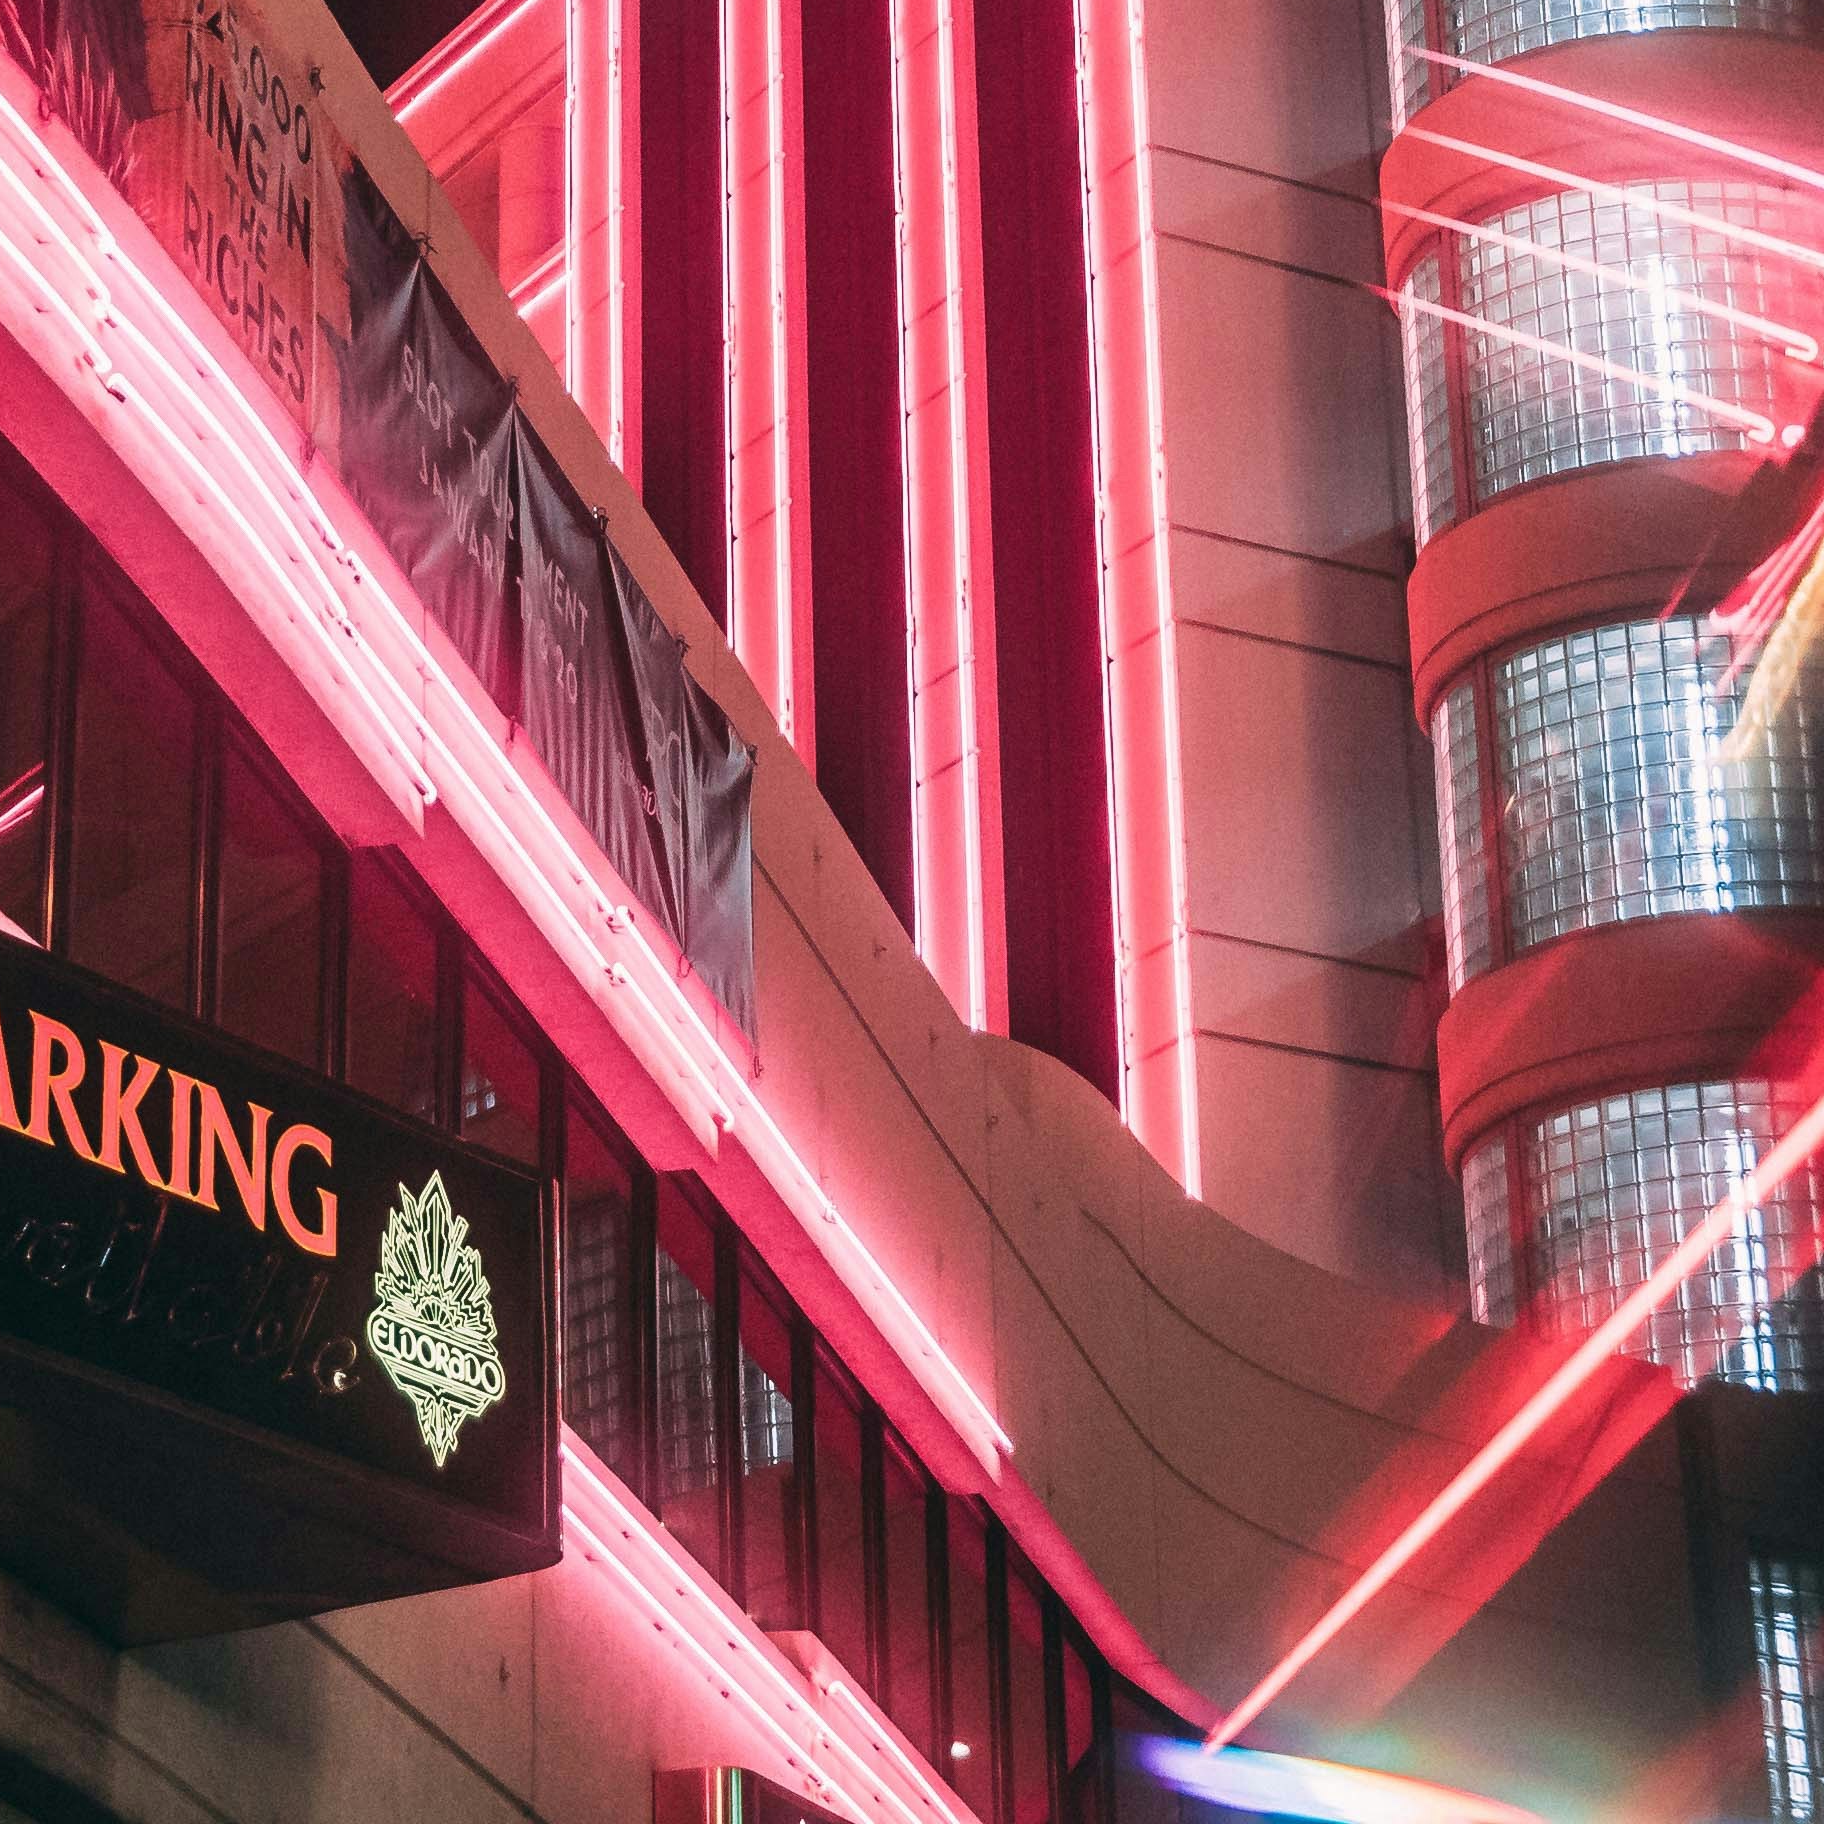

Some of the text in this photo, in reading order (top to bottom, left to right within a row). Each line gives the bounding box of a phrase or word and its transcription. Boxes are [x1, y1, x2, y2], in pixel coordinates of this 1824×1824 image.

[185, 29, 312, 268] RING IN
[224, 173, 268, 273] THE
[183, 180, 306, 404] RICHES
[402, 344, 456, 449] SLOT
[419, 446, 506, 596] JANUARY
[555, 643, 578, 705] 20
